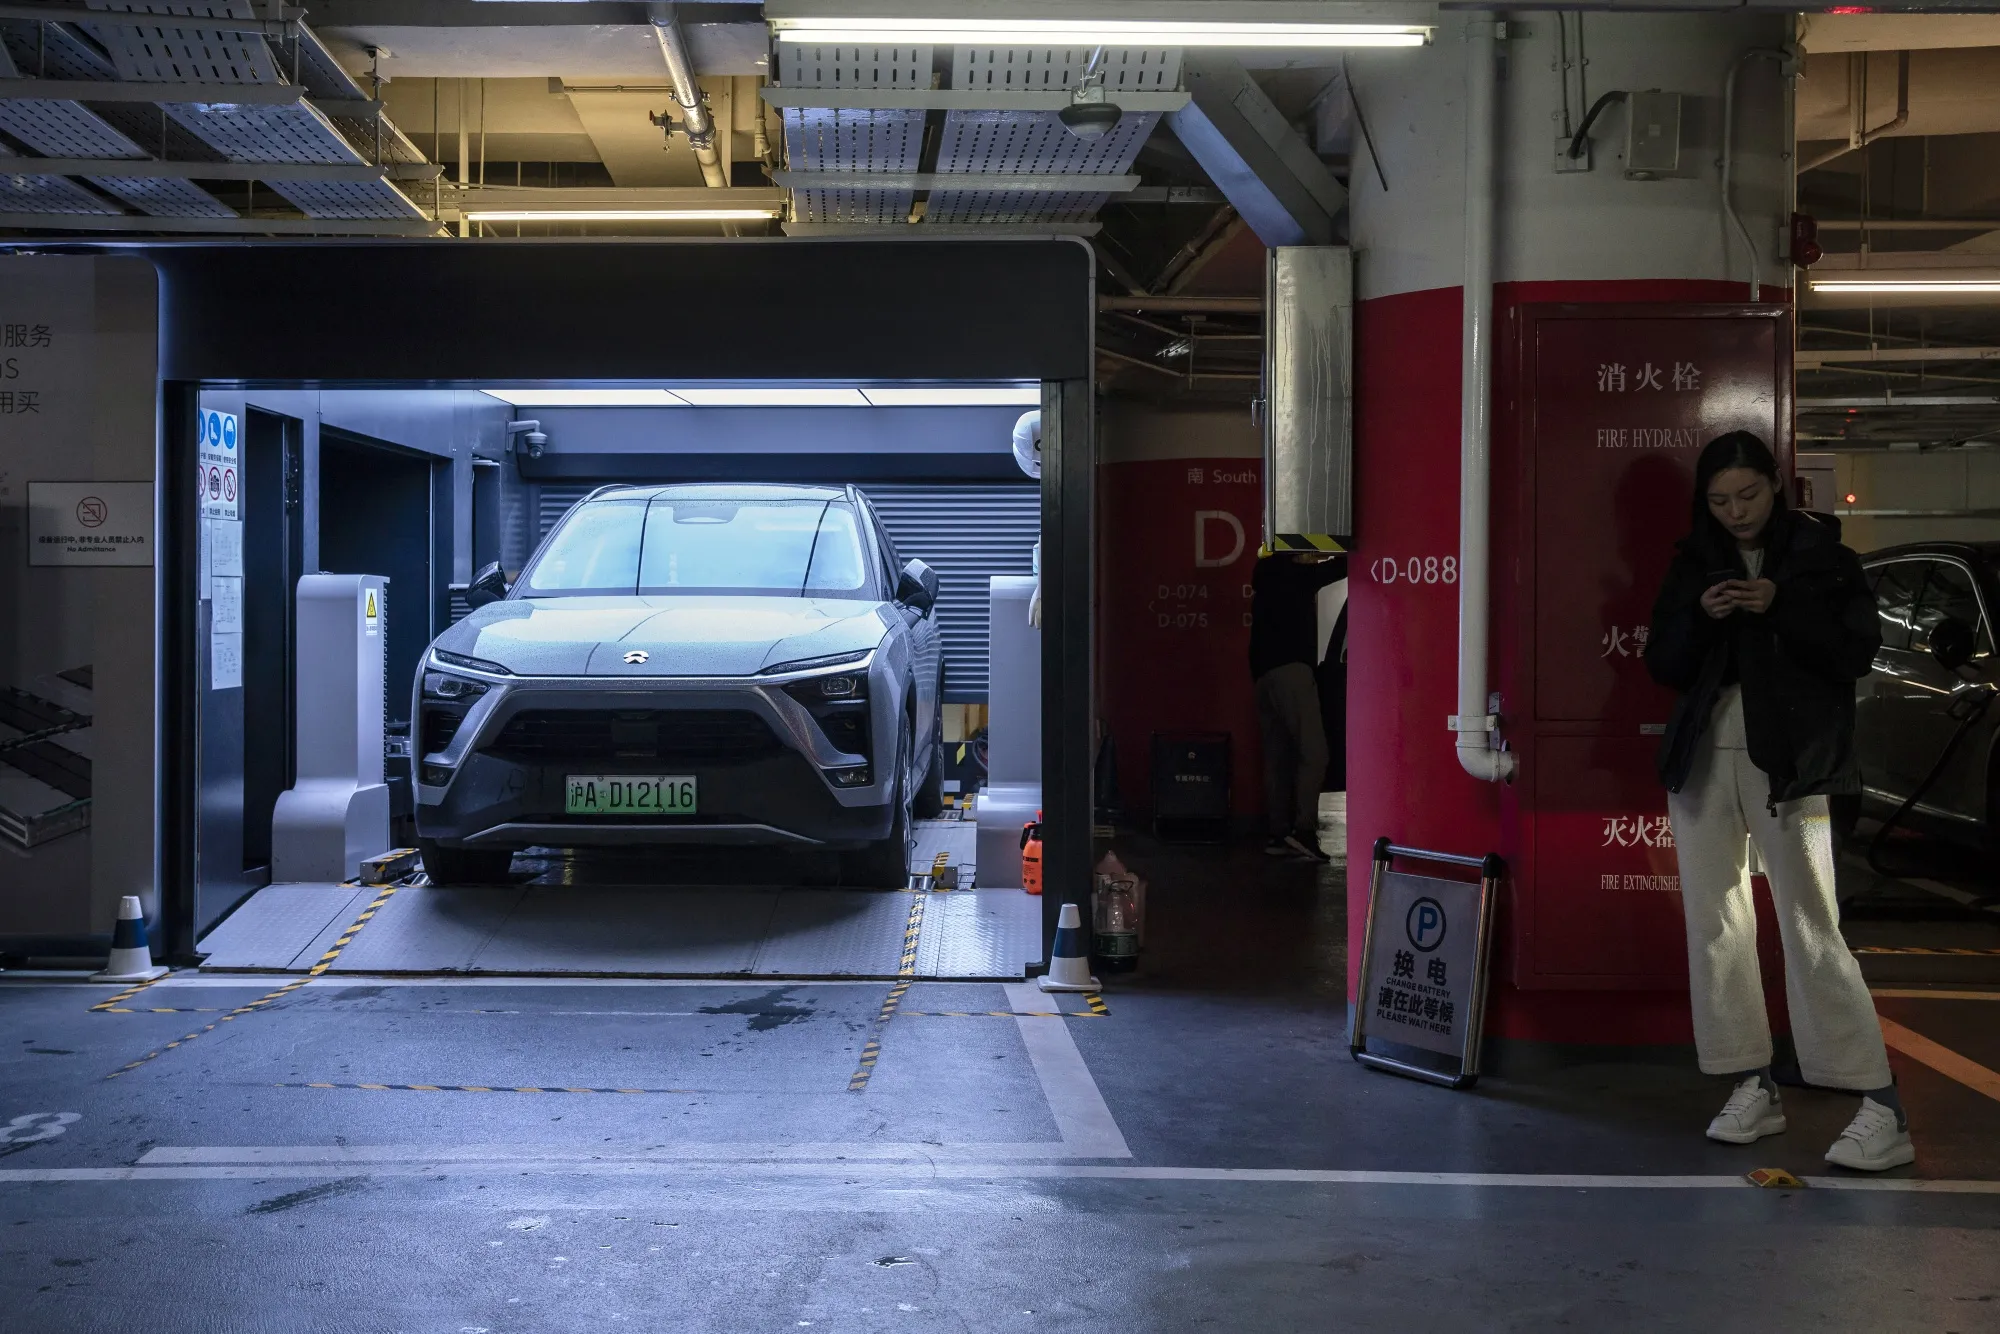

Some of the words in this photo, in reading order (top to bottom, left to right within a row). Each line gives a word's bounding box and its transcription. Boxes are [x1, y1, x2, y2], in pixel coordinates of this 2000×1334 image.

[0, 324, 52, 348] 服务
[0, 358, 19, 379] S
[1597, 362, 1702, 392] 消火栓
[1597, 428, 1628, 448] FIRE
[1632, 428, 1703, 448] HYDRANT
[1187, 468, 1203, 484] 南
[1213, 469, 1256, 484] South
[1195, 510, 1246, 568] D
[1158, 584, 1208, 600] D-074
[1158, 613, 1208, 628] D-075
[1601, 874, 1620, 890] FIRE
[1623, 874, 1682, 891] EXTINGUISHE
[1417, 905, 1438, 942] P
[1393, 949, 1447, 986] 换电
[1386, 976, 1417, 991] CHANGE
[1417, 984, 1451, 999] BATTERY
[1378, 986, 1455, 1023] 请在此等候
[1376, 1008, 1408, 1024] PLEASE
[1408, 1016, 1429, 1030] WAIT
[1429, 1022, 1452, 1035] HERE
